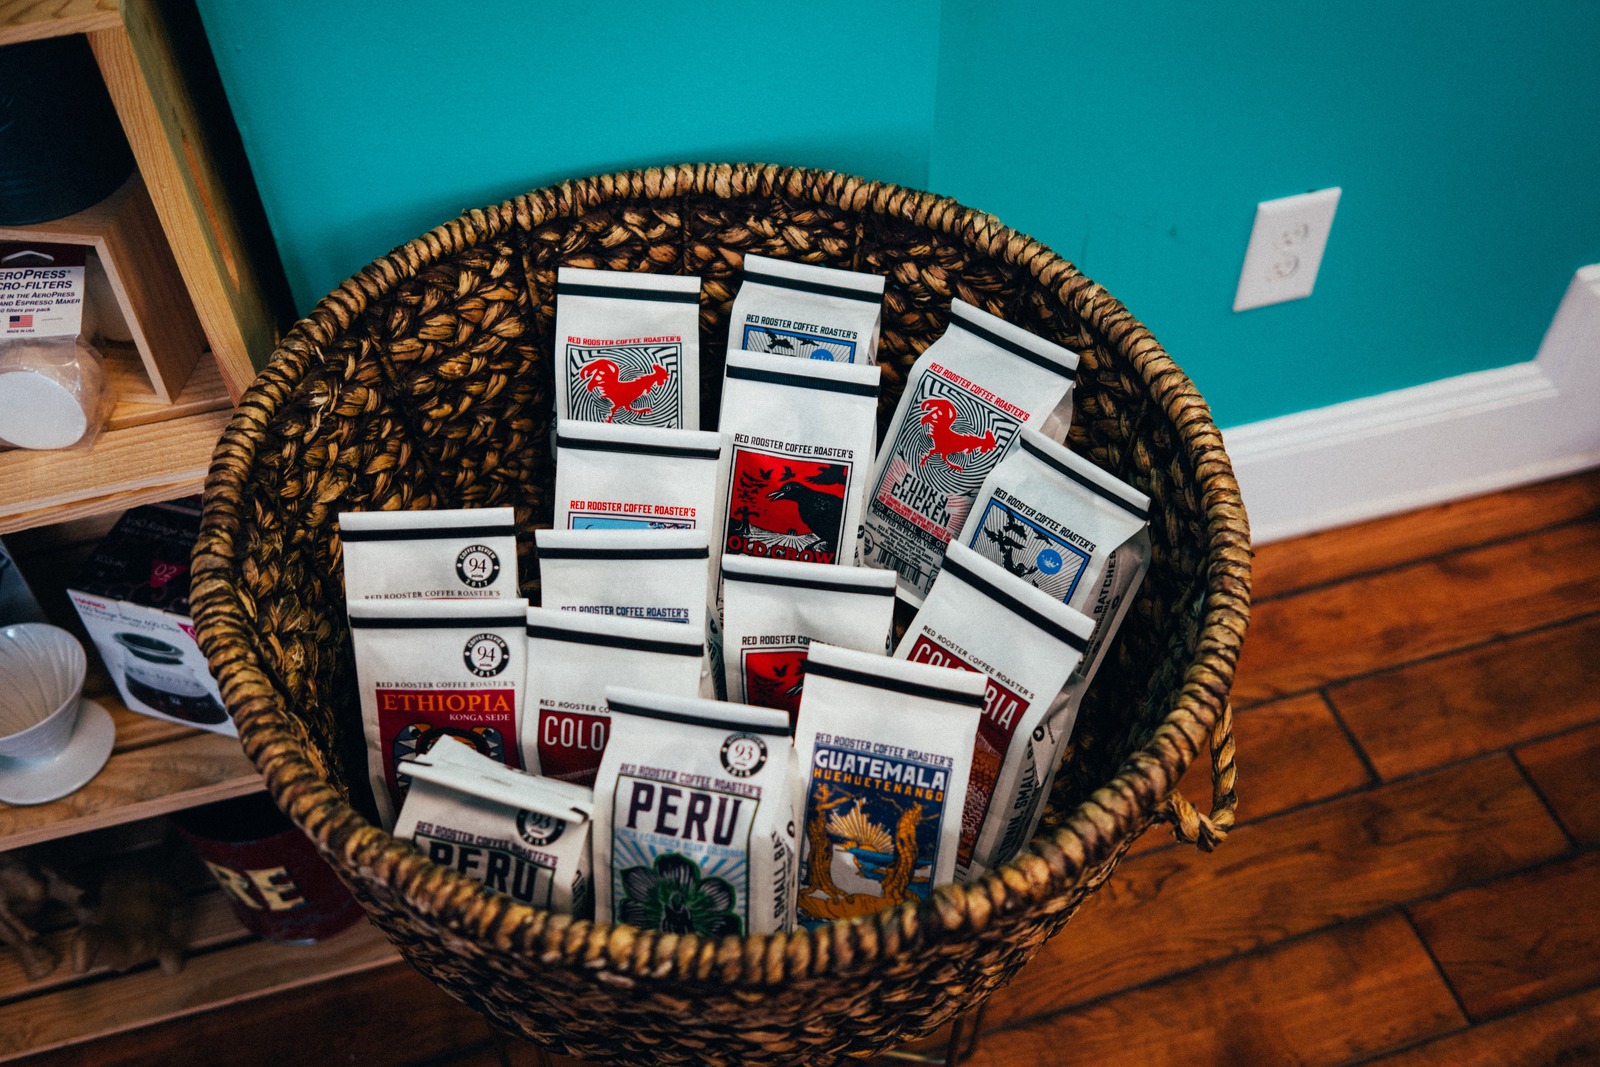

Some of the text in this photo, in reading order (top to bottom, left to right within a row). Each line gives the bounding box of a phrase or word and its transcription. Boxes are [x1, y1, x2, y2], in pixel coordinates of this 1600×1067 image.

[568, 336, 582, 345] RED
[583, 336, 614, 346] ROOSTER
[644, 336, 681, 344] ROASTER'S
[746, 314, 858, 340] RED ROOSTER COFFEE ROASTER'S
[929, 362, 1030, 422] RED ROOSTER COFFEE ROASTER'S
[734, 433, 854, 459] RED ROOSTER COFFEE ROASTER'S
[891, 482, 952, 529] CHICKEN
[902, 473, 949, 510] FUNKY
[570, 500, 696, 517] RED ROOSTER COFFEE ROASTER'S
[994, 487, 1096, 552] RED ROOSTER COFFEE ROASTER'S
[872, 508, 894, 525] ROASTED
[902, 527, 923, 544] FLOYD,
[886, 508, 918, 532] MEDICINAL
[920, 530, 932, 541] USE
[728, 535, 835, 564] OLD CROW
[468, 557, 488, 574] 94
[384, 592, 422, 600] ROOSTER
[1092, 550, 1116, 614] BATCHES
[616, 606, 644, 617] COFFEE
[646, 607, 688, 618] ROASTER'S
[477, 646, 496, 662] 94
[742, 636, 758, 646] RED
[760, 634, 796, 645] ROOSTER
[922, 625, 1036, 700] RED ROOSTER COFFEE ROASTER'S
[383, 694, 510, 712] ETHIOPIA
[449, 714, 482, 722] KONGA
[540, 699, 556, 708] RED
[558, 700, 596, 712] ROOSTER
[735, 743, 754, 761] 93
[815, 732, 954, 767] RED ROOSTER COFFEE ROASTER'S
[620, 763, 762, 799] RED ROOSTER COFFEE ROASTER'S
[814, 749, 946, 790] GUATEMALA
[814, 768, 944, 802] HUEHUETENANGO
[626, 781, 743, 846] PERU
[416, 820, 433, 833] RED
[434, 825, 476, 843] ROOSTER
[477, 835, 511, 850] COFFEE
[429, 841, 538, 903] PERU
